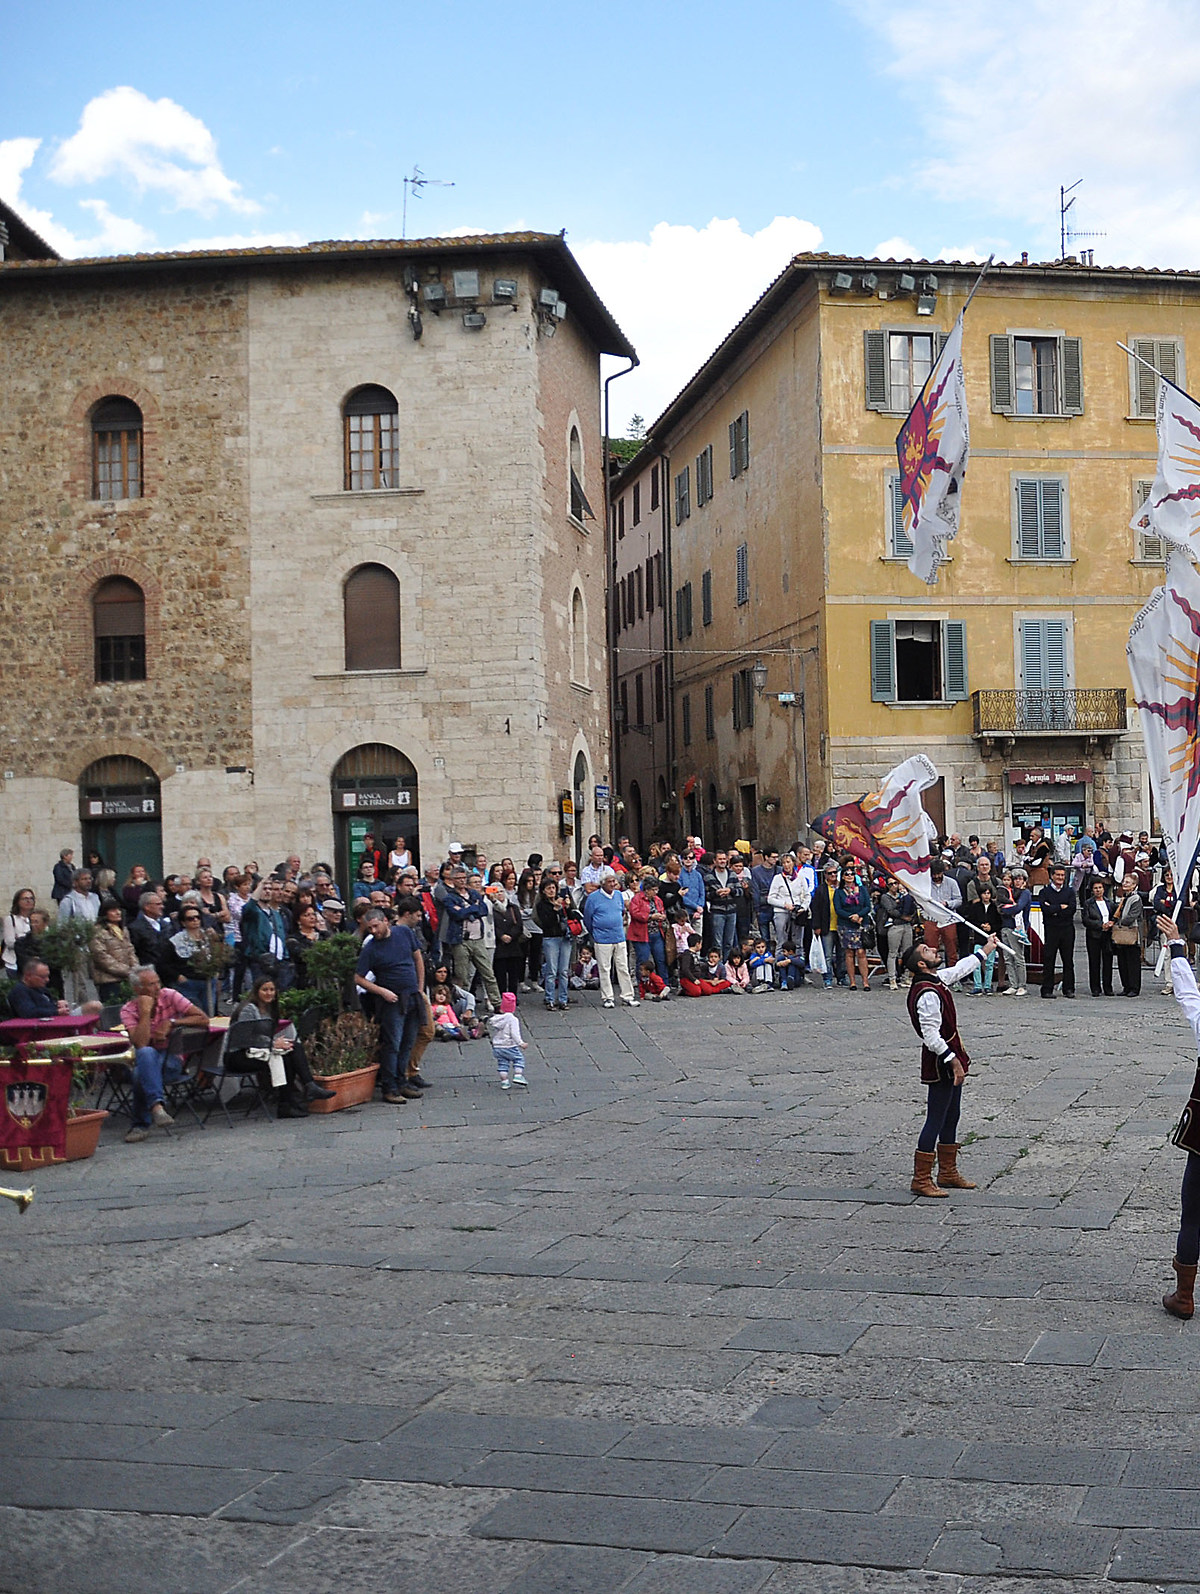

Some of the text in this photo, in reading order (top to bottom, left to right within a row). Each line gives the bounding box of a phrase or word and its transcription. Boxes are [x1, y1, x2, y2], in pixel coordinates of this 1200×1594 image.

[1024, 773, 1076, 782] Agenzia Viaggi
[369, 798, 395, 806] FIRENZE
[115, 806, 140, 814] FIRENZE
